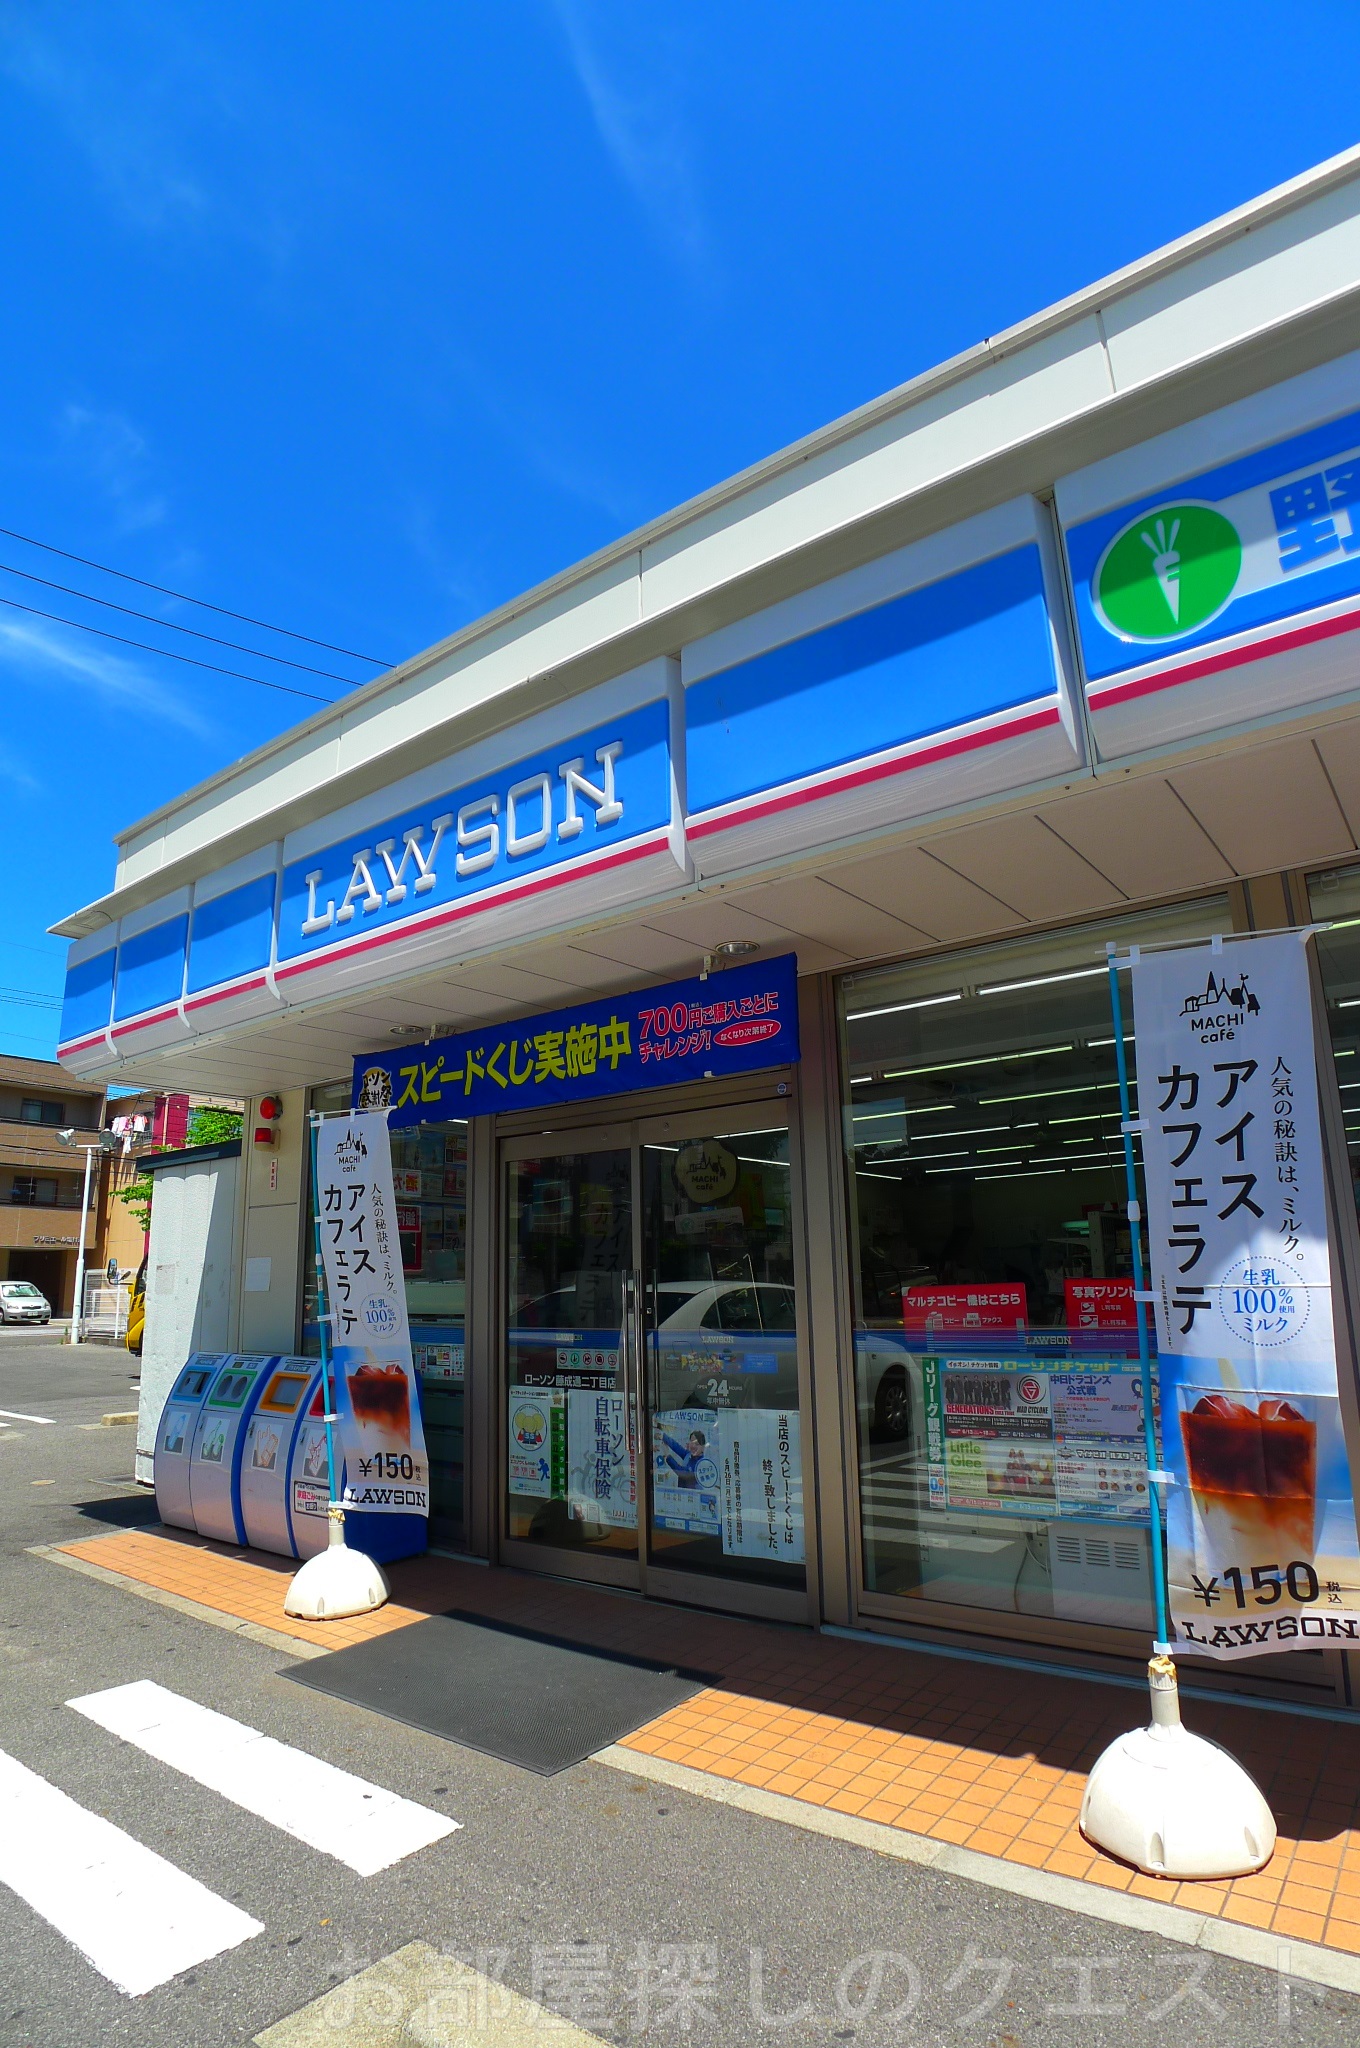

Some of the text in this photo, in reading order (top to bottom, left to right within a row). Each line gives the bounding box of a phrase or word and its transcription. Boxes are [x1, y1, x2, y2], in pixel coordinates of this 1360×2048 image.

[302, 740, 623, 936] LAWSON
[1190, 1013, 1244, 1031] MACHI
[1200, 1028, 1236, 1044] café
[398, 1015, 632, 1107] スピードくじ実施中
[1213, 1058, 1265, 1221] アイス
[338, 1156, 361, 1165] MACHI
[1270, 1056, 1305, 1261] 人気の秘訣は、ミルク。
[691, 1175, 719, 1183] MACHI
[1156, 1064, 1212, 1335] カフェラテ
[347, 1184, 377, 1275] アイス
[371, 1182, 398, 1295] 人気の秘訣は、ミルク。
[324, 1184, 358, 1335] カフェラテ
[1242, 1268, 1280, 1286] 生乳
[906, 1293, 1021, 1308] マルチコピー機はこちら
[1232, 1288, 1294, 1314] 100%
[1243, 1316, 1288, 1333] ミルク
[701, 1335, 734, 1344] LAWSON
[1025, 1335, 1072, 1346] LAWSON
[1003, 1361, 1118, 1372] ローソンチケット
[707, 1378, 729, 1397] 24
[669, 1411, 704, 1421] LAWSON
[611, 1398, 625, 1467] ローソン
[594, 1395, 611, 1500] 自転車保険
[950, 1440, 981, 1454] Little
[951, 1454, 982, 1468] Glee
[777, 1414, 794, 1545] 当店のスピードくじは
[348, 1488, 427, 1508] LAWSON
[762, 1458, 779, 1555] 終了致しました。
[1181, 1616, 1360, 1648] LAWSON
